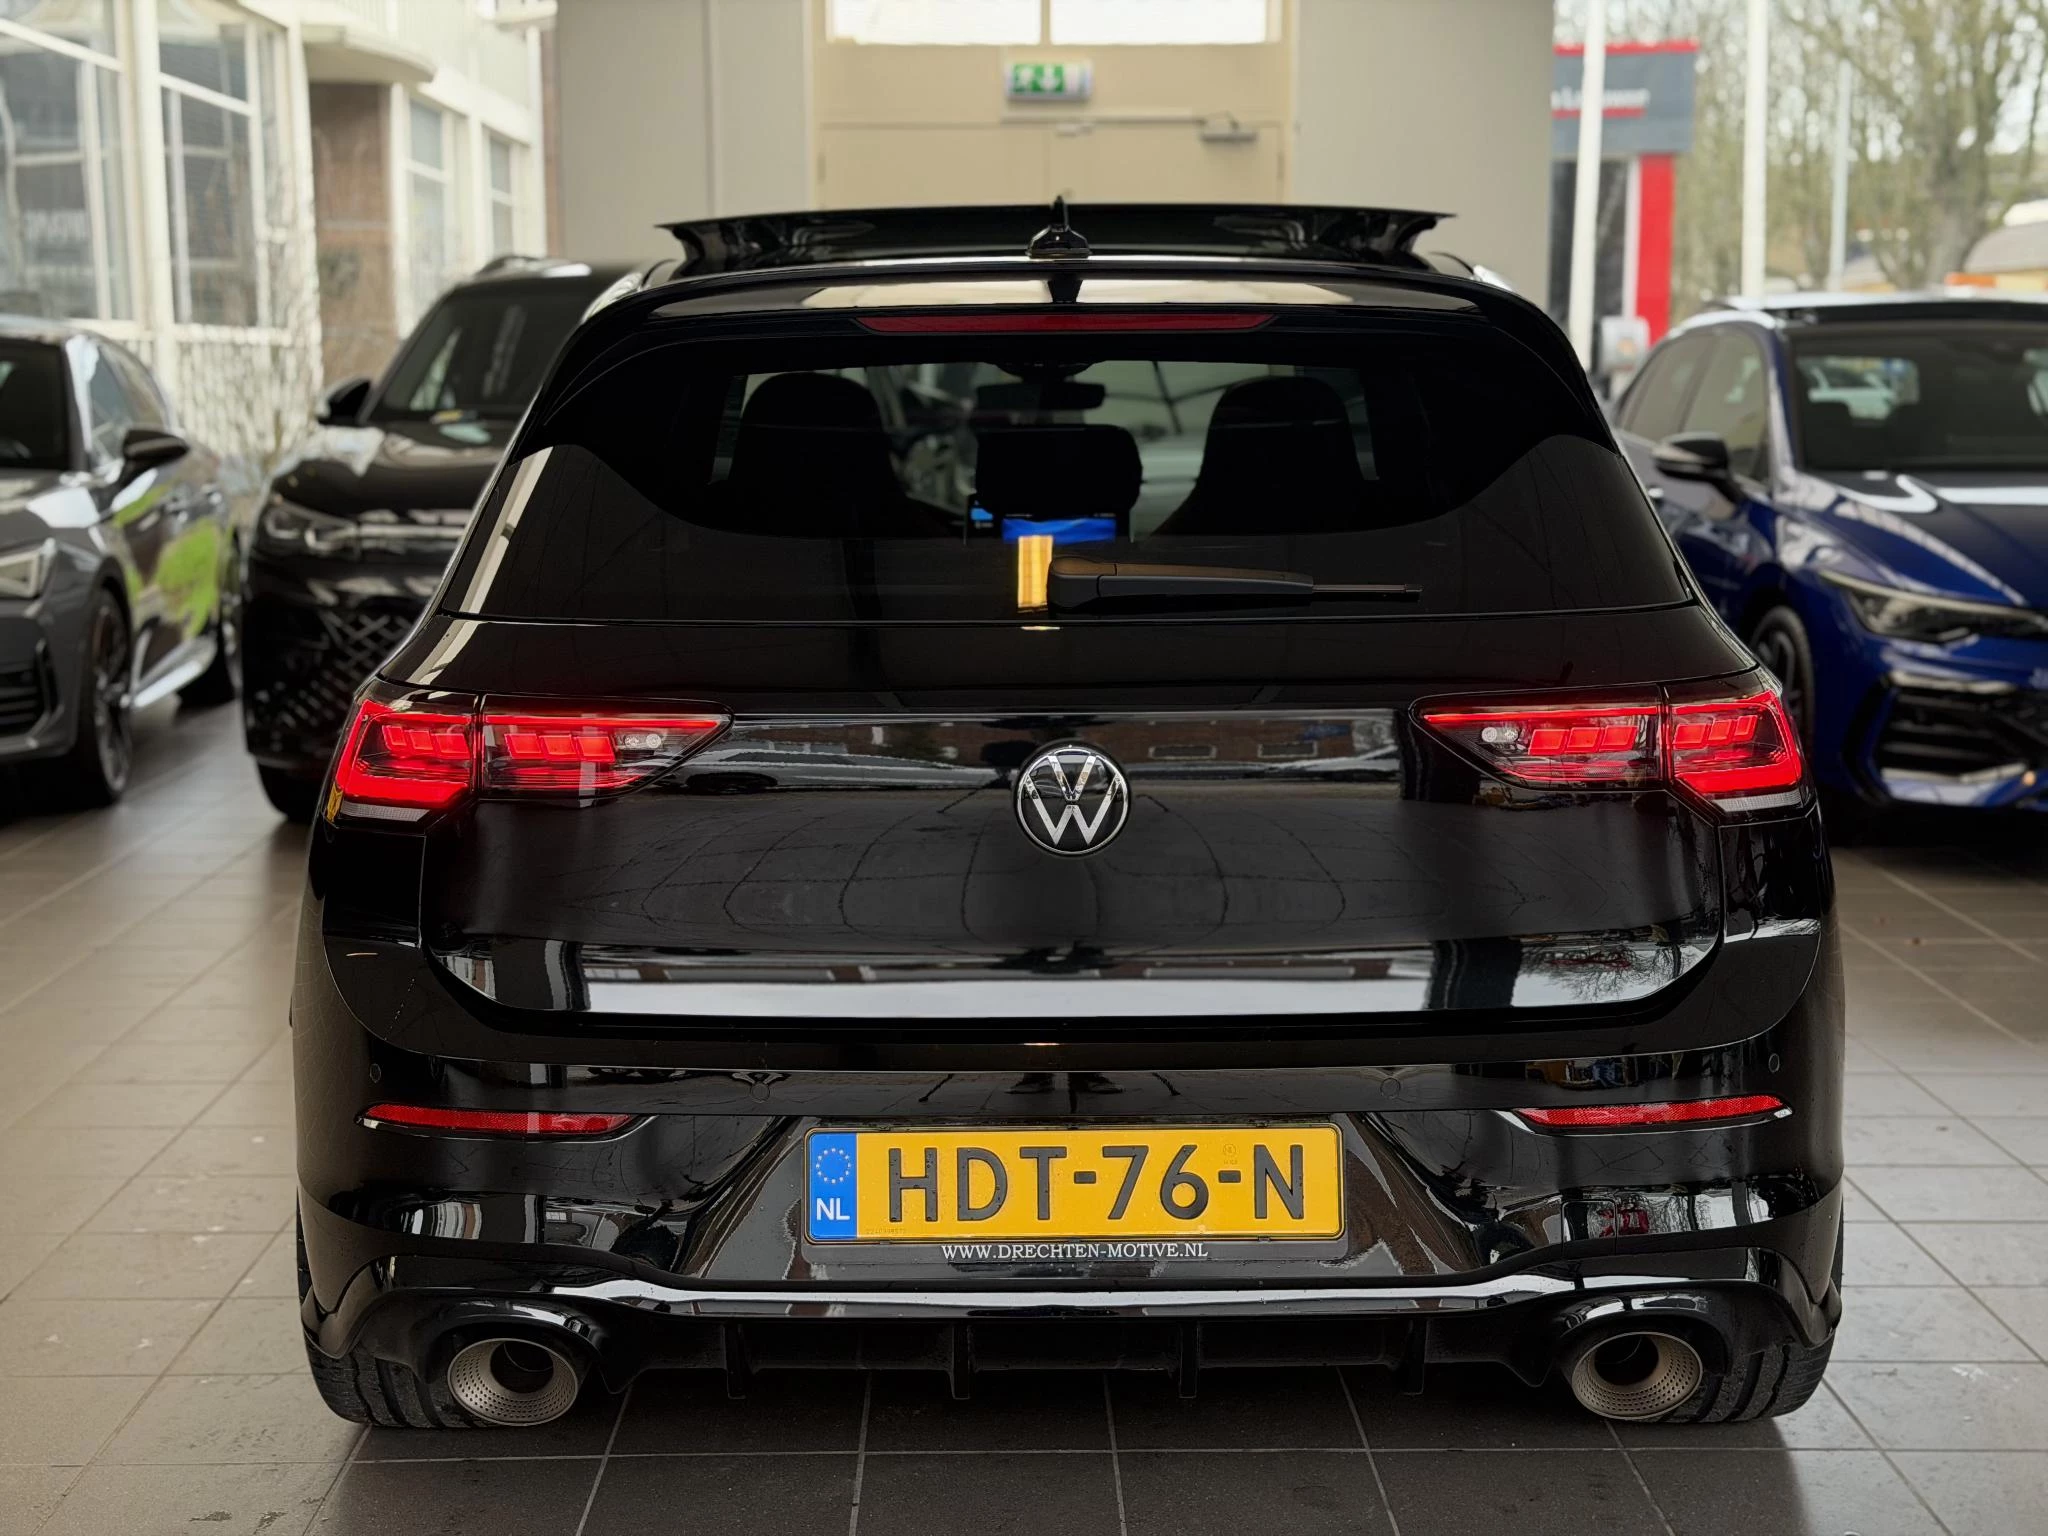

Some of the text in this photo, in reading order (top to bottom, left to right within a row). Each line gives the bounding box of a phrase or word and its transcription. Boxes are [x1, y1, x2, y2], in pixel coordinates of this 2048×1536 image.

[888, 1144, 1304, 1222] HDT-76-N
[816, 1198, 850, 1221] NL
[941, 1243, 1208, 1259] WWW.DRECHTEN-MOTIVE.NL
